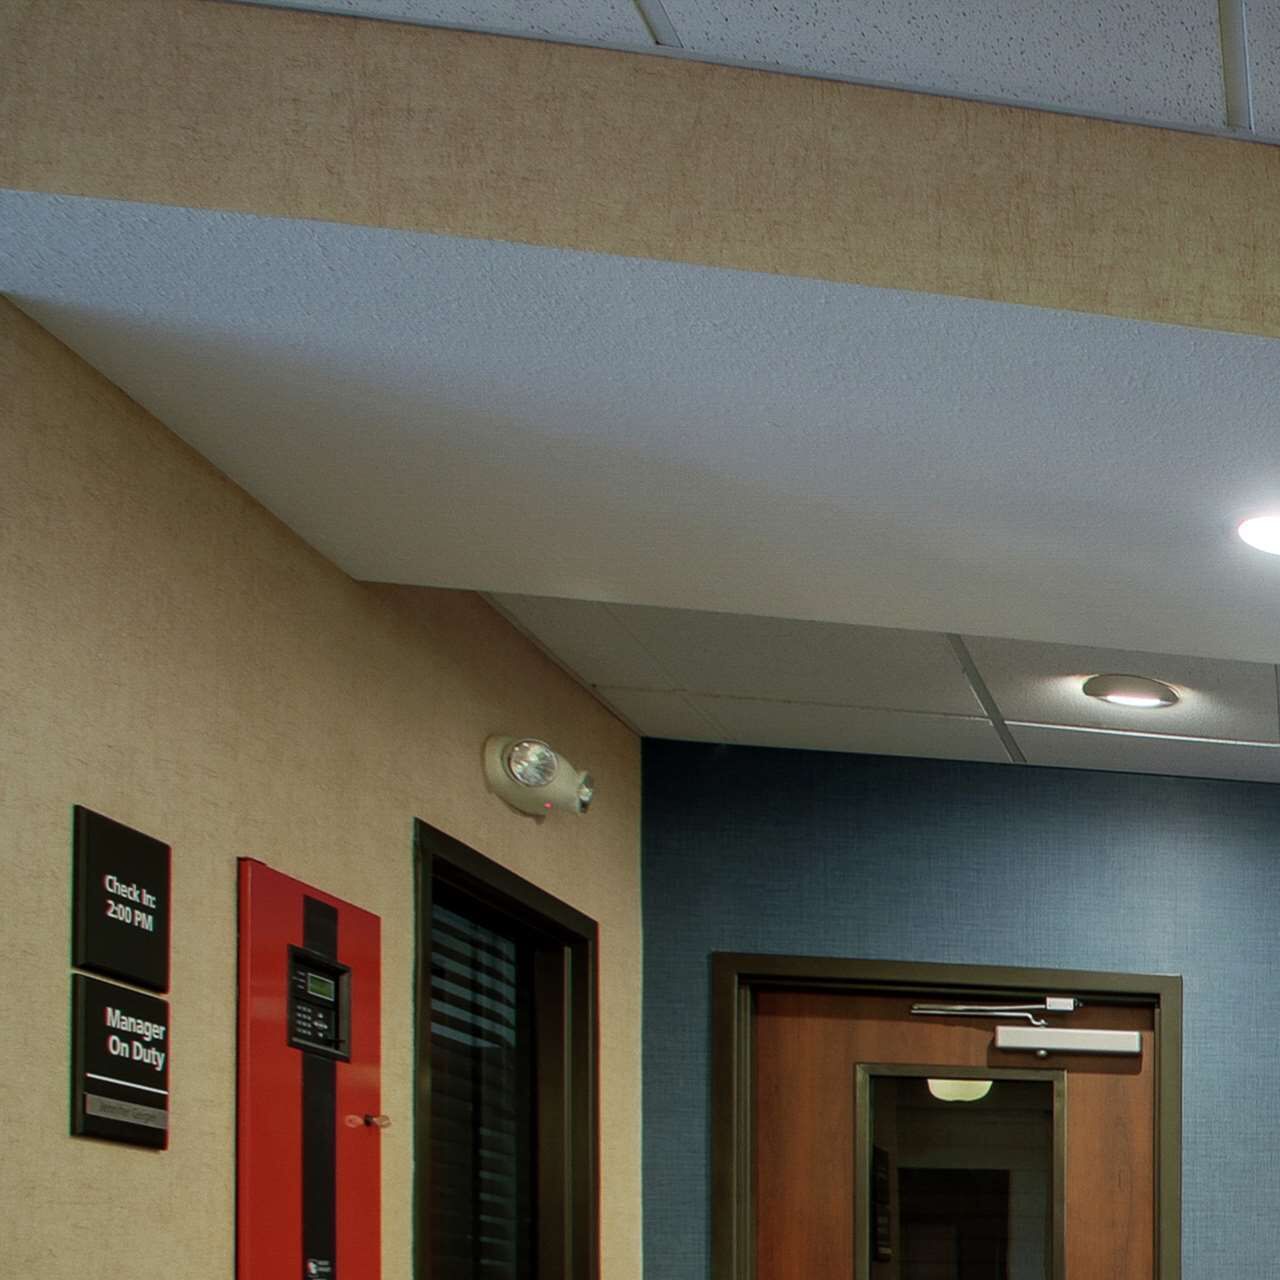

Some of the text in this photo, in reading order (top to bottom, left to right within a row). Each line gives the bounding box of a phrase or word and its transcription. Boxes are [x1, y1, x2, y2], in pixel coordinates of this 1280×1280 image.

[104, 875, 140, 903] Check
[106, 900, 154, 932] 2:00 PM
[104, 1006, 166, 1041] Manager
[107, 1035, 166, 1071] On Duty
